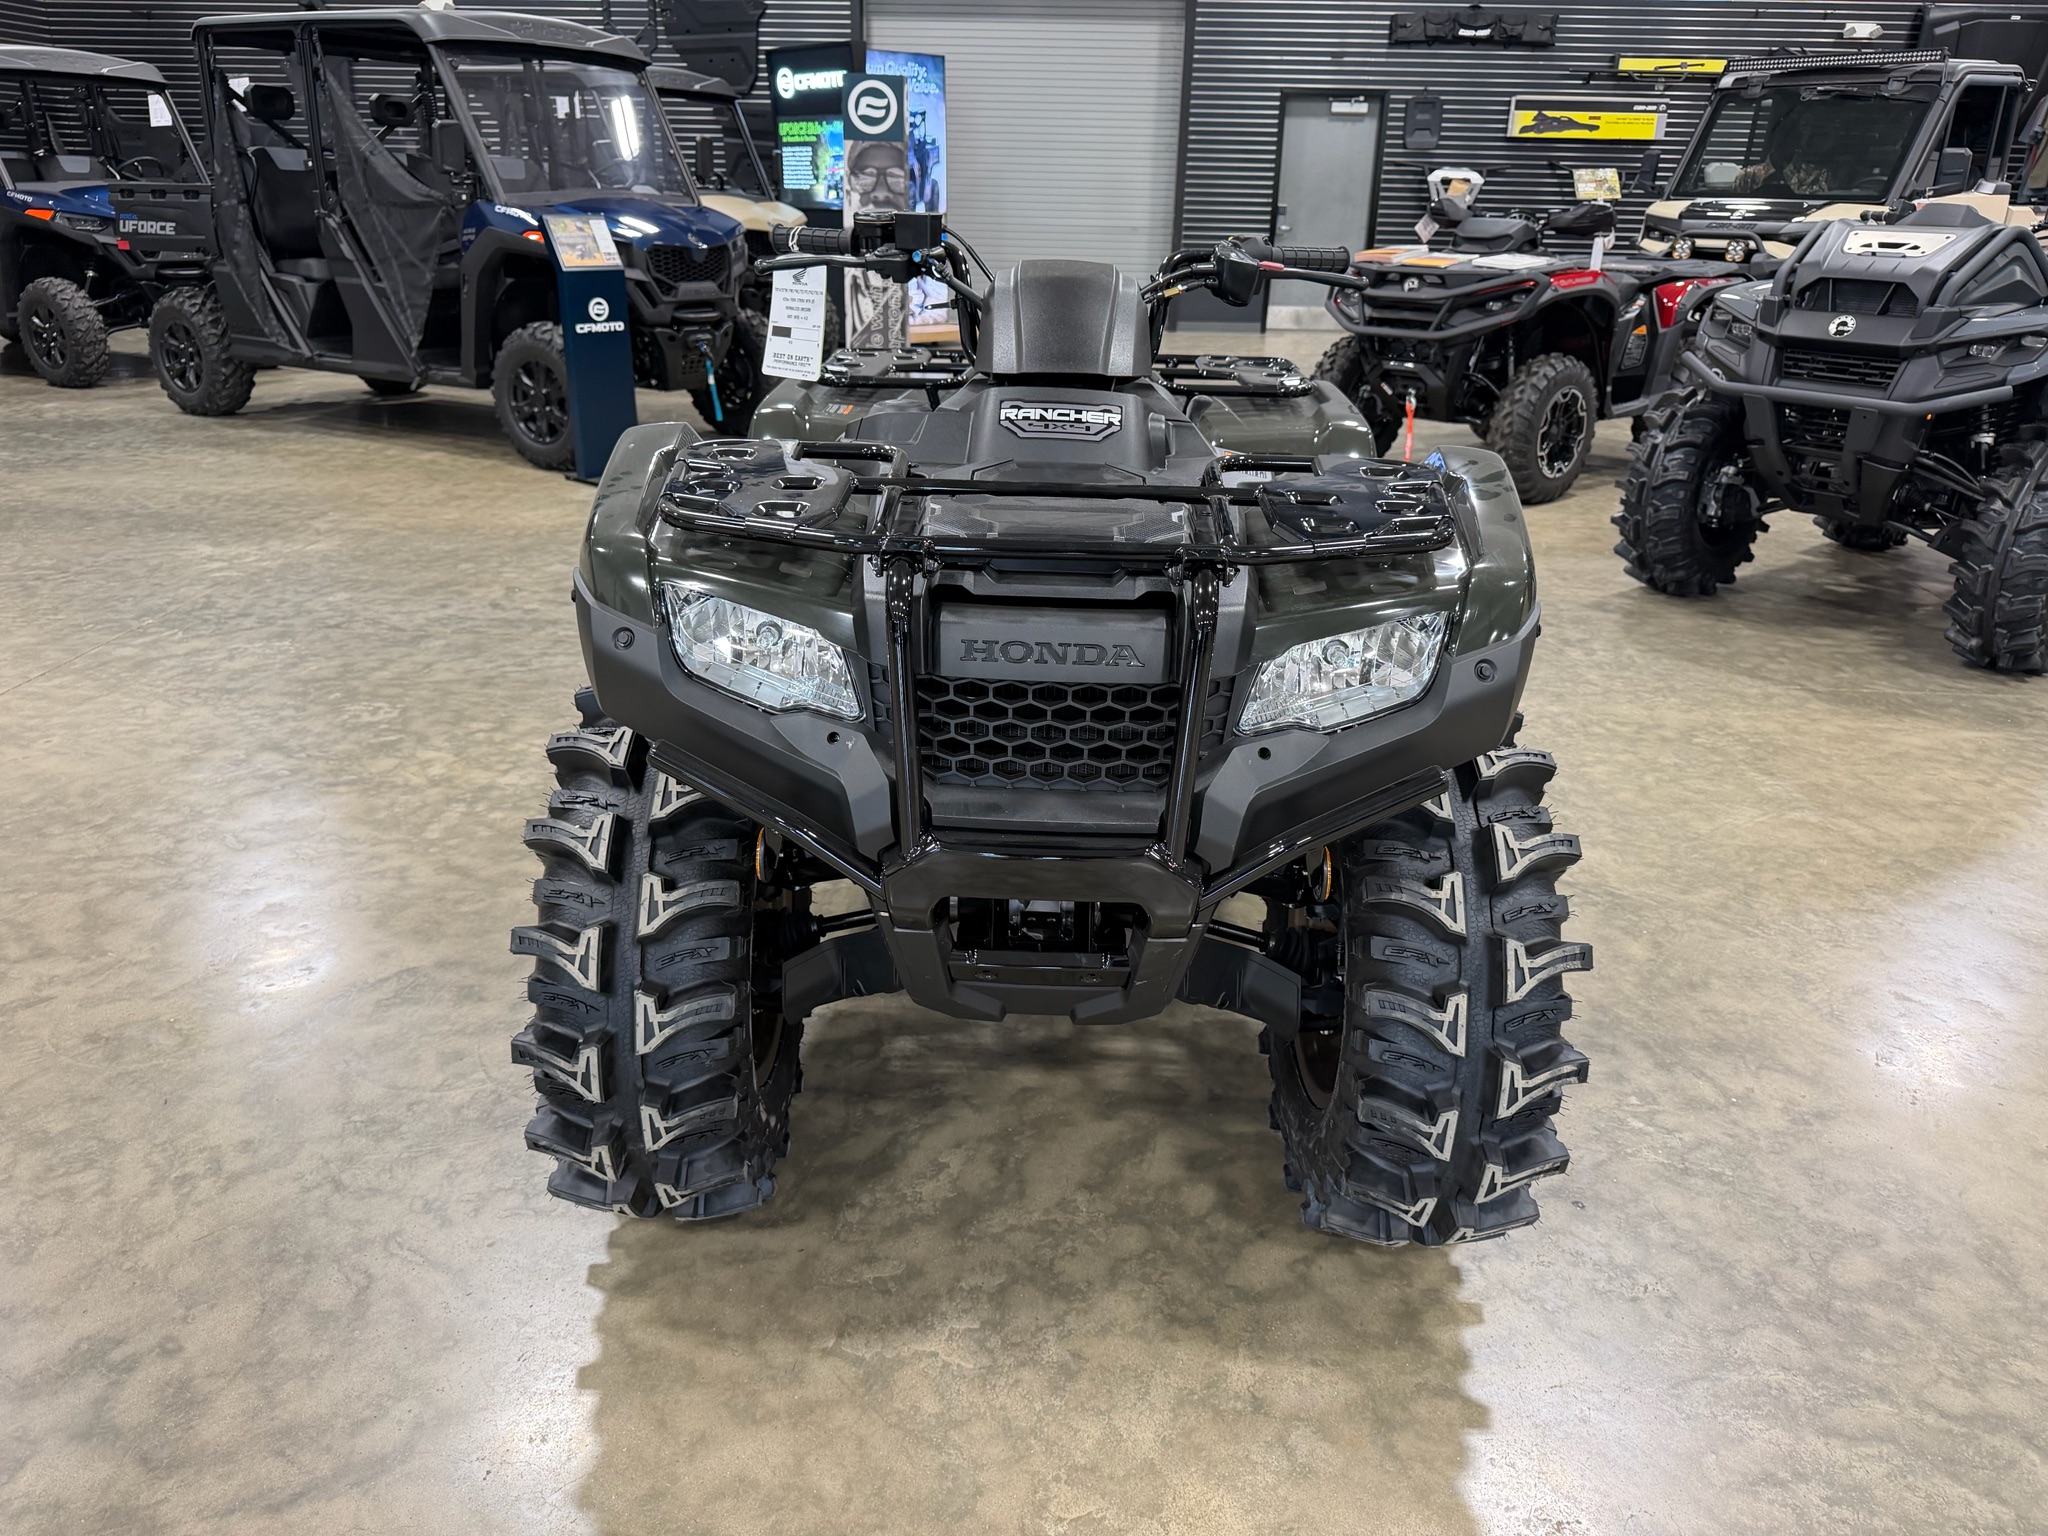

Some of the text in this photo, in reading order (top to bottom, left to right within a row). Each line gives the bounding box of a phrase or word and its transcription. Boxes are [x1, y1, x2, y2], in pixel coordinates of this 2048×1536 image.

[6, 191, 33, 203] CFMOTO
[119, 220, 176, 236] UFORCE
[575, 321, 625, 334] CFMOTO
[1000, 408, 1121, 426] RANCHER
[960, 639, 1145, 667] HONDA
